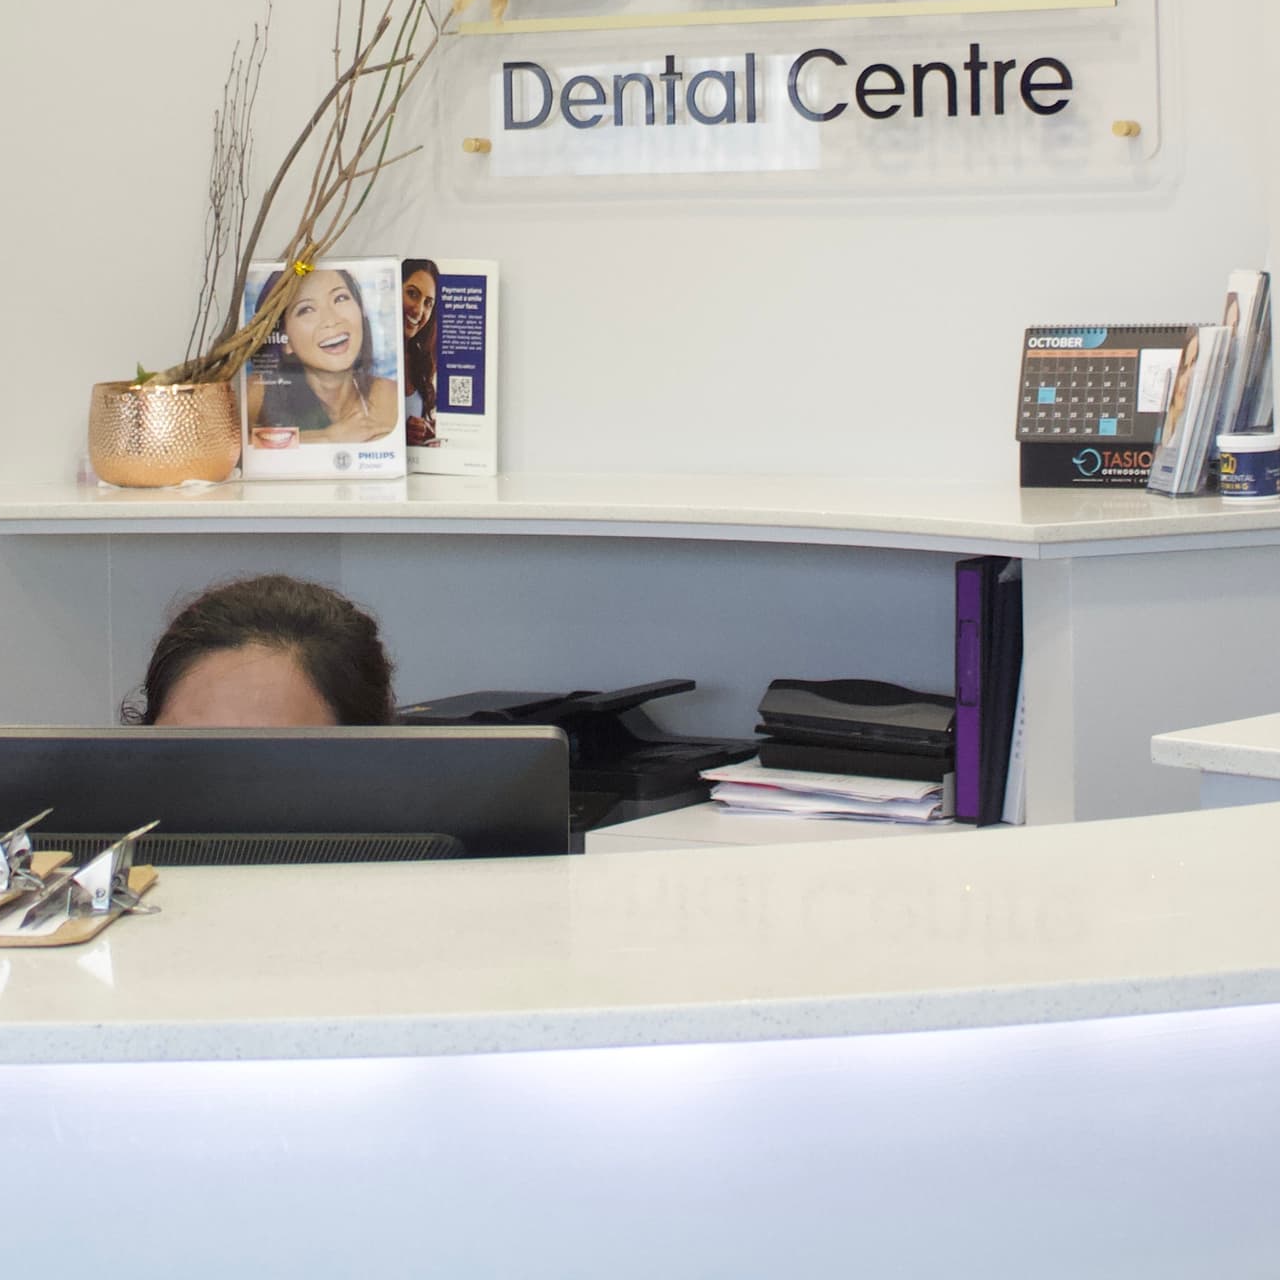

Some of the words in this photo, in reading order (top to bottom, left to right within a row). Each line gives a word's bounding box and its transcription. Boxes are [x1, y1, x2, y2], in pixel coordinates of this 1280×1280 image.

[502, 52, 756, 130] Dental
[788, 42, 1073, 122] Centre
[442, 286, 466, 295] Payment
[1028, 337, 1083, 348] OCTOBER
[358, 451, 395, 460] PHILIPS
[1102, 451, 1153, 468] TASIO
